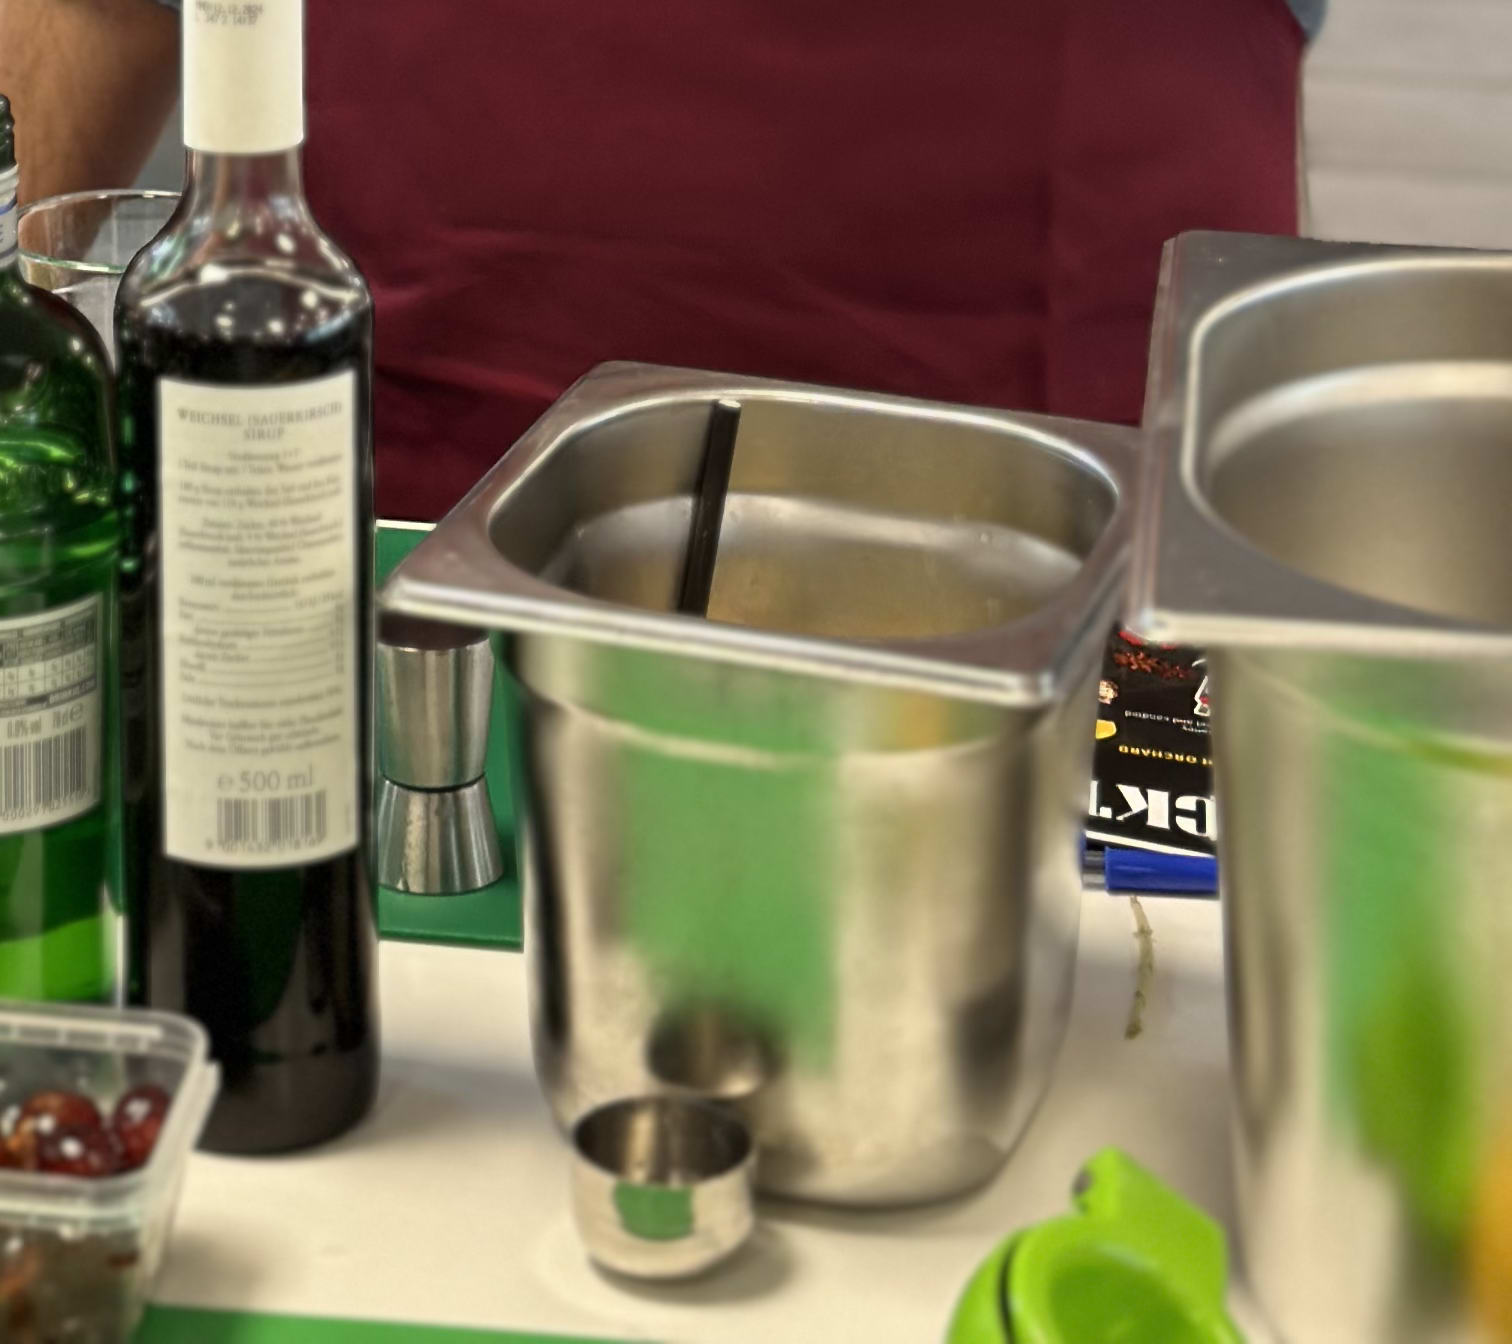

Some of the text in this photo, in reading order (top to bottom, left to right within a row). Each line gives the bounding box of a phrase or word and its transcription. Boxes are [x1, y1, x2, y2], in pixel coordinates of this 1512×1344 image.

[243, 427, 286, 441] SIRUP
[1117, 744, 1198, 765] ORCHARD
[239, 764, 313, 793] 500 ml
